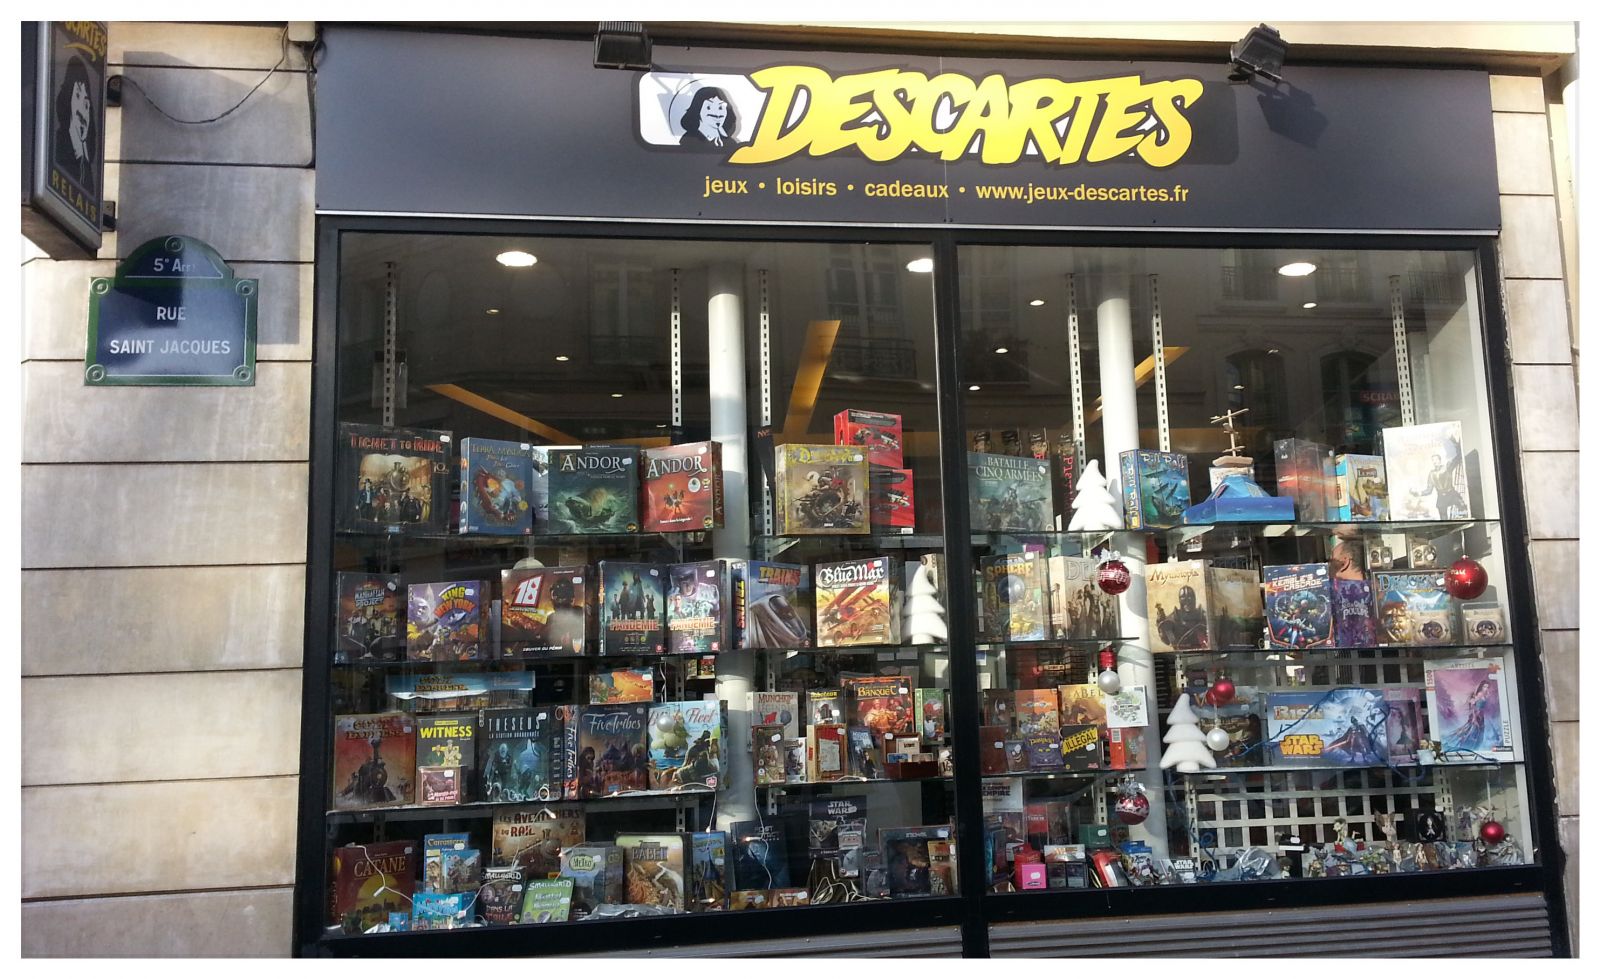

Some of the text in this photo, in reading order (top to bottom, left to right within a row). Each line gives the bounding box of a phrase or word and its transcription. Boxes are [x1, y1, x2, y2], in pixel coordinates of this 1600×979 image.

[728, 65, 1204, 168] DESCARTES
[52, 168, 98, 223] RELAIS
[703, 175, 1189, 204] jeux loisirs cadeaux www.jeux-descartes.fr
[156, 306, 187, 321] RUE
[109, 339, 231, 354] SAINT JACQUES
[561, 454, 626, 474] ANDOR
[647, 454, 708, 479] ANDOR
[976, 465, 1003, 481] CINQ
[441, 586, 466, 601] KING
[488, 715, 541, 732] THESEUS
[420, 726, 473, 739] WITNESS
[1064, 729, 1098, 751] ILLEGAL
[1284, 734, 1320, 746] STAR
[1281, 743, 1324, 756] WARS
[510, 826, 535, 837] RAIL
[354, 855, 406, 877] CATANE
